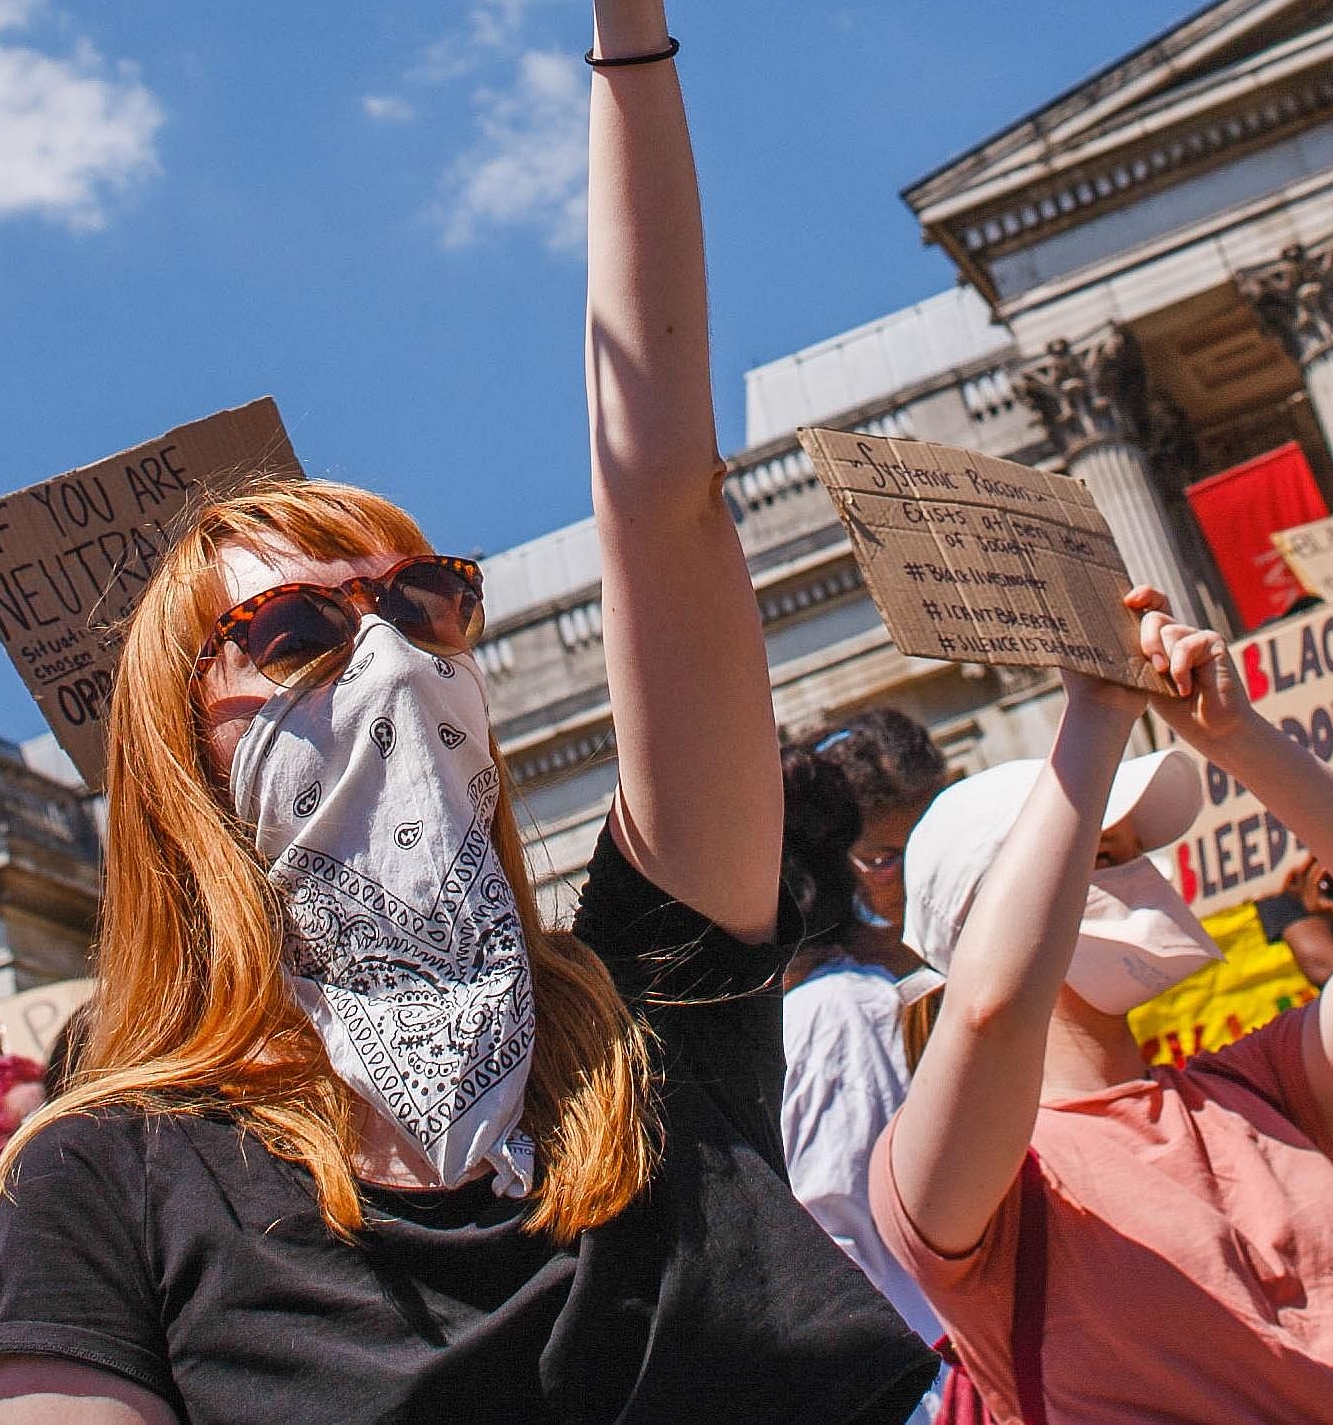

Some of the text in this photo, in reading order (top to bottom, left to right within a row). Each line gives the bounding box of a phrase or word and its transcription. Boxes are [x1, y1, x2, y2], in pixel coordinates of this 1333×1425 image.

[29, 476, 115, 538] YOU
[124, 445, 189, 515] ARE
[1176, 810, 1308, 905] BLEED
